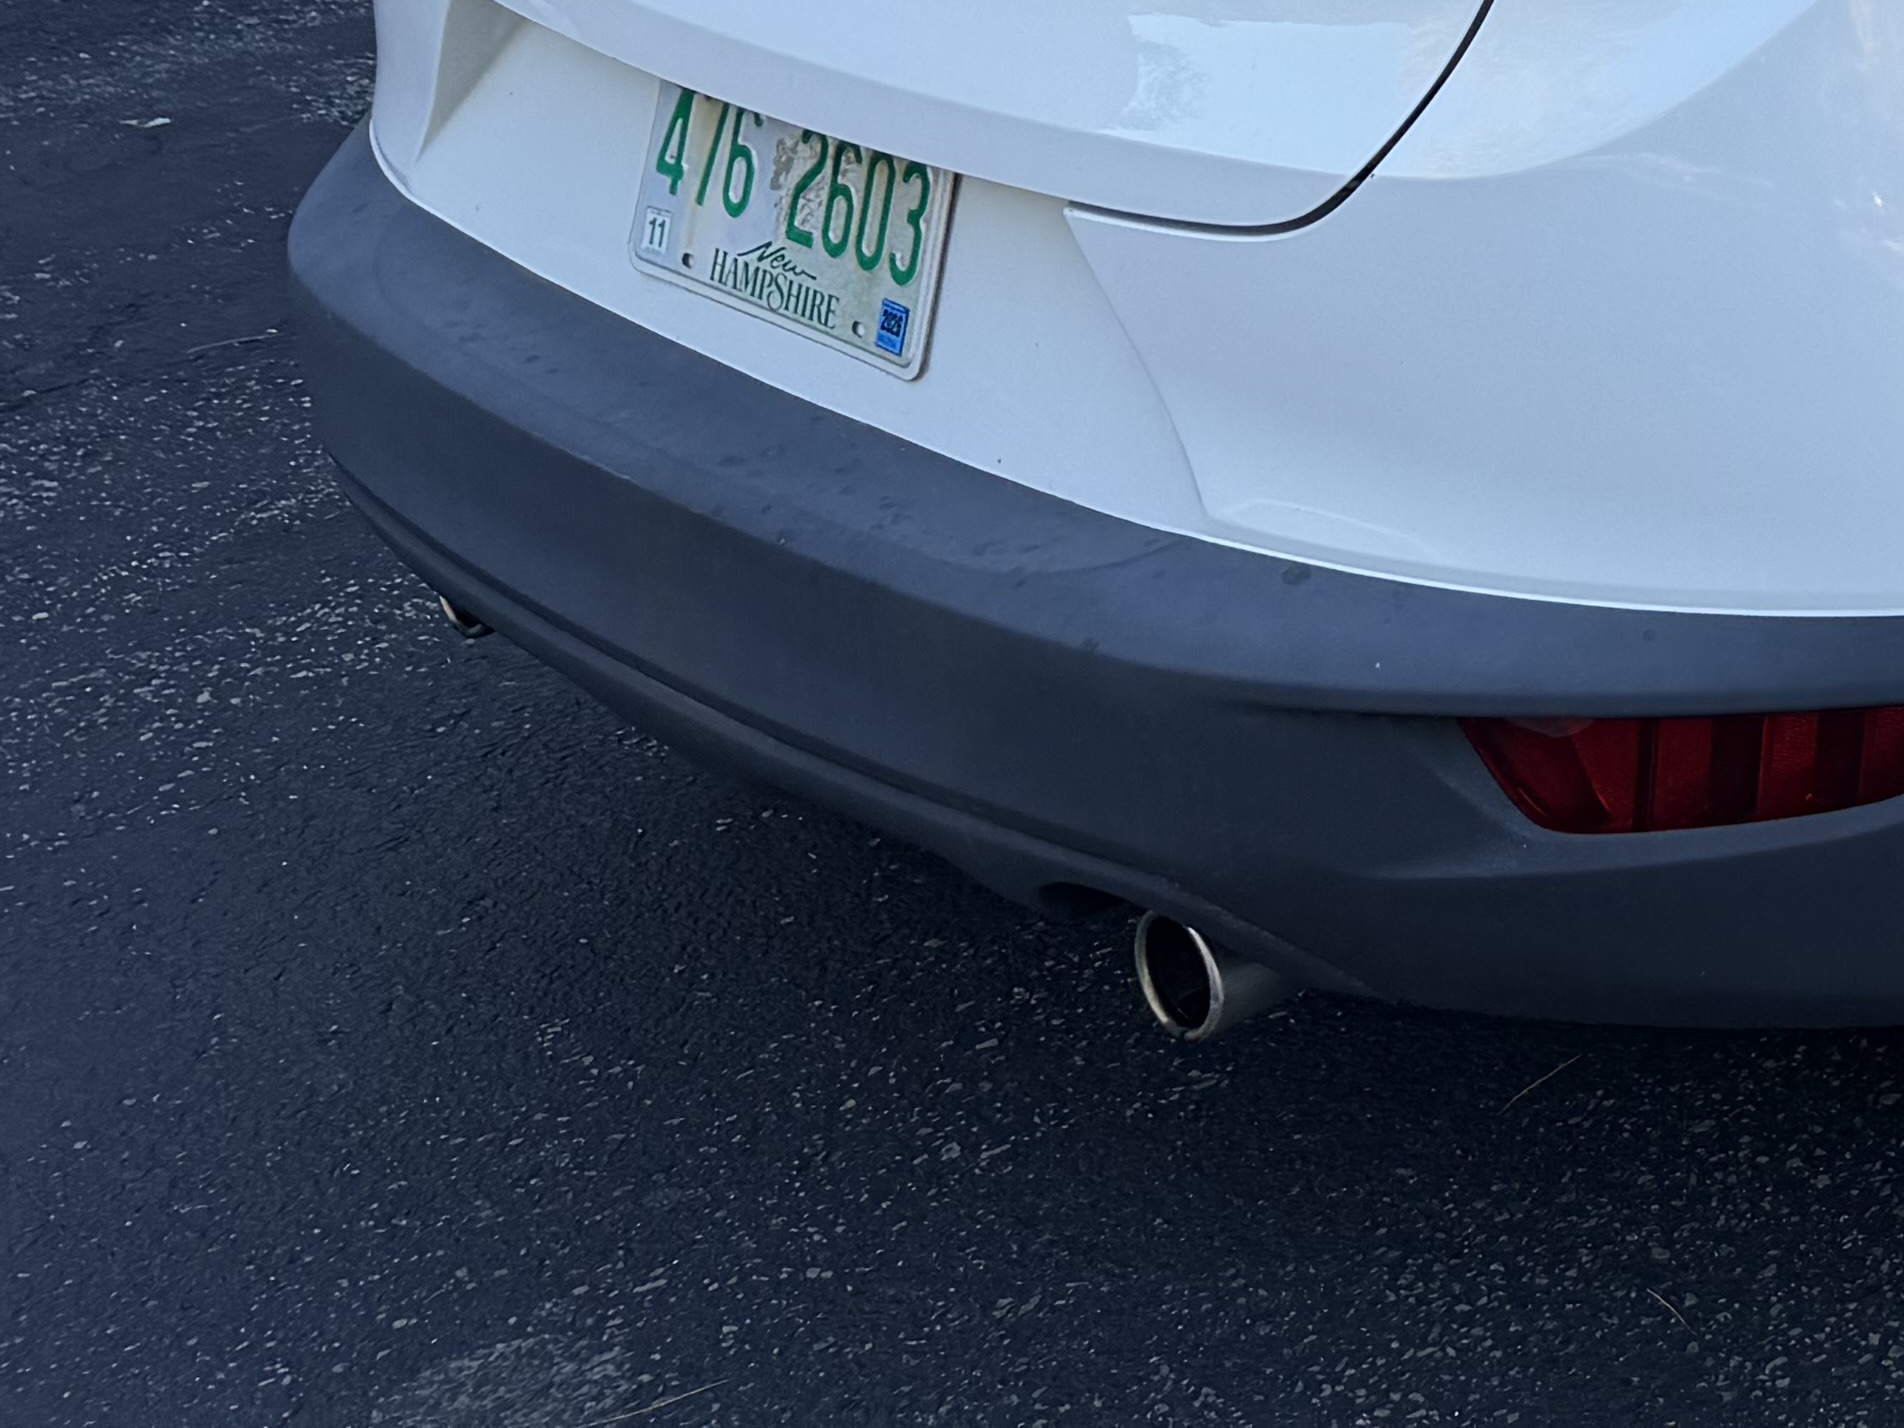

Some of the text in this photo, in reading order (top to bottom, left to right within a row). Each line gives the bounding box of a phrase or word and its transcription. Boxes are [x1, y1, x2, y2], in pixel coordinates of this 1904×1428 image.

[785, 128, 931, 286] 2603
[709, 247, 840, 331] HAMPSHIRE
[737, 240, 817, 281] New
